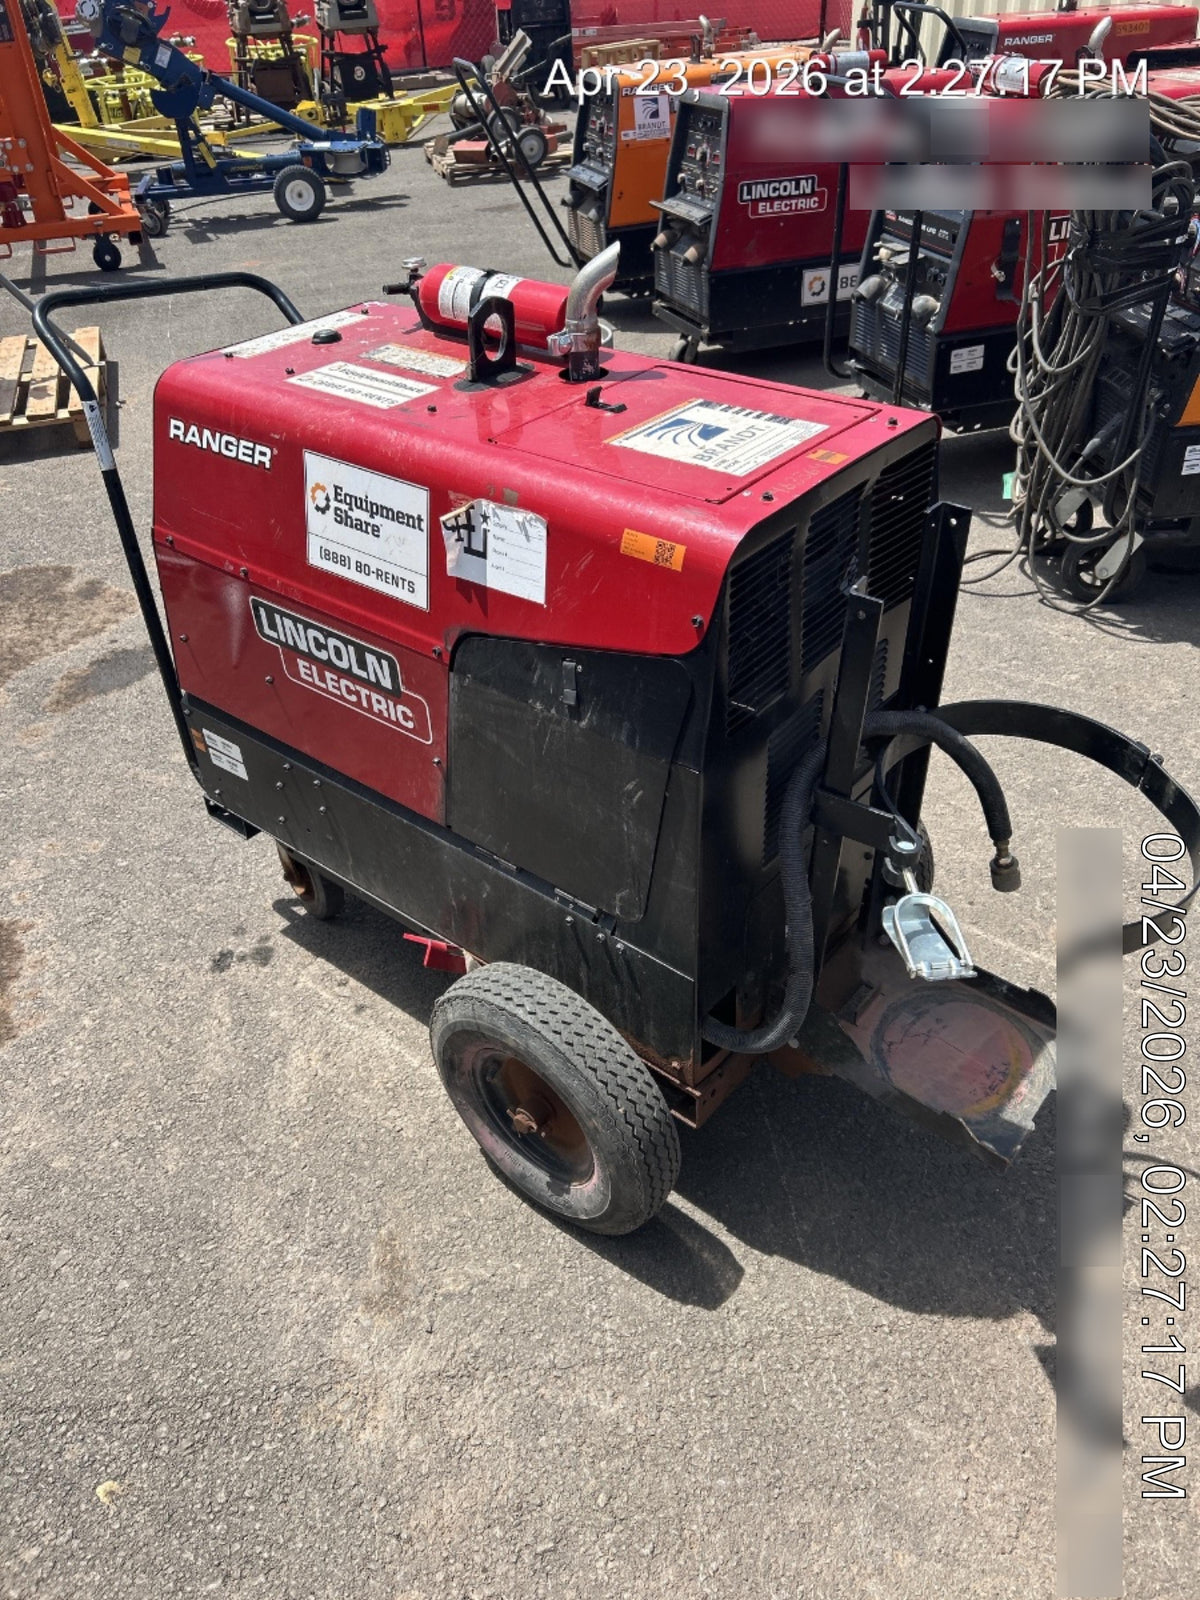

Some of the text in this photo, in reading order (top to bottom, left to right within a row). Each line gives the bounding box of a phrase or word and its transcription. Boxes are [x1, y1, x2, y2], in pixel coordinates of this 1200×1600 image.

[1004, 34, 1053, 46] RANGER
[742, 179, 814, 202] LINCOLN
[757, 197, 820, 215] ELECTRIC
[168, 417, 273, 470] RANGER
[693, 424, 768, 462] BRANDT
[333, 484, 425, 533] Equipment
[333, 508, 382, 539] Share
[318, 544, 416, 595] (888) 80-RENTS
[258, 605, 393, 692] LINCOLN
[297, 658, 415, 730] ELECTRIC
